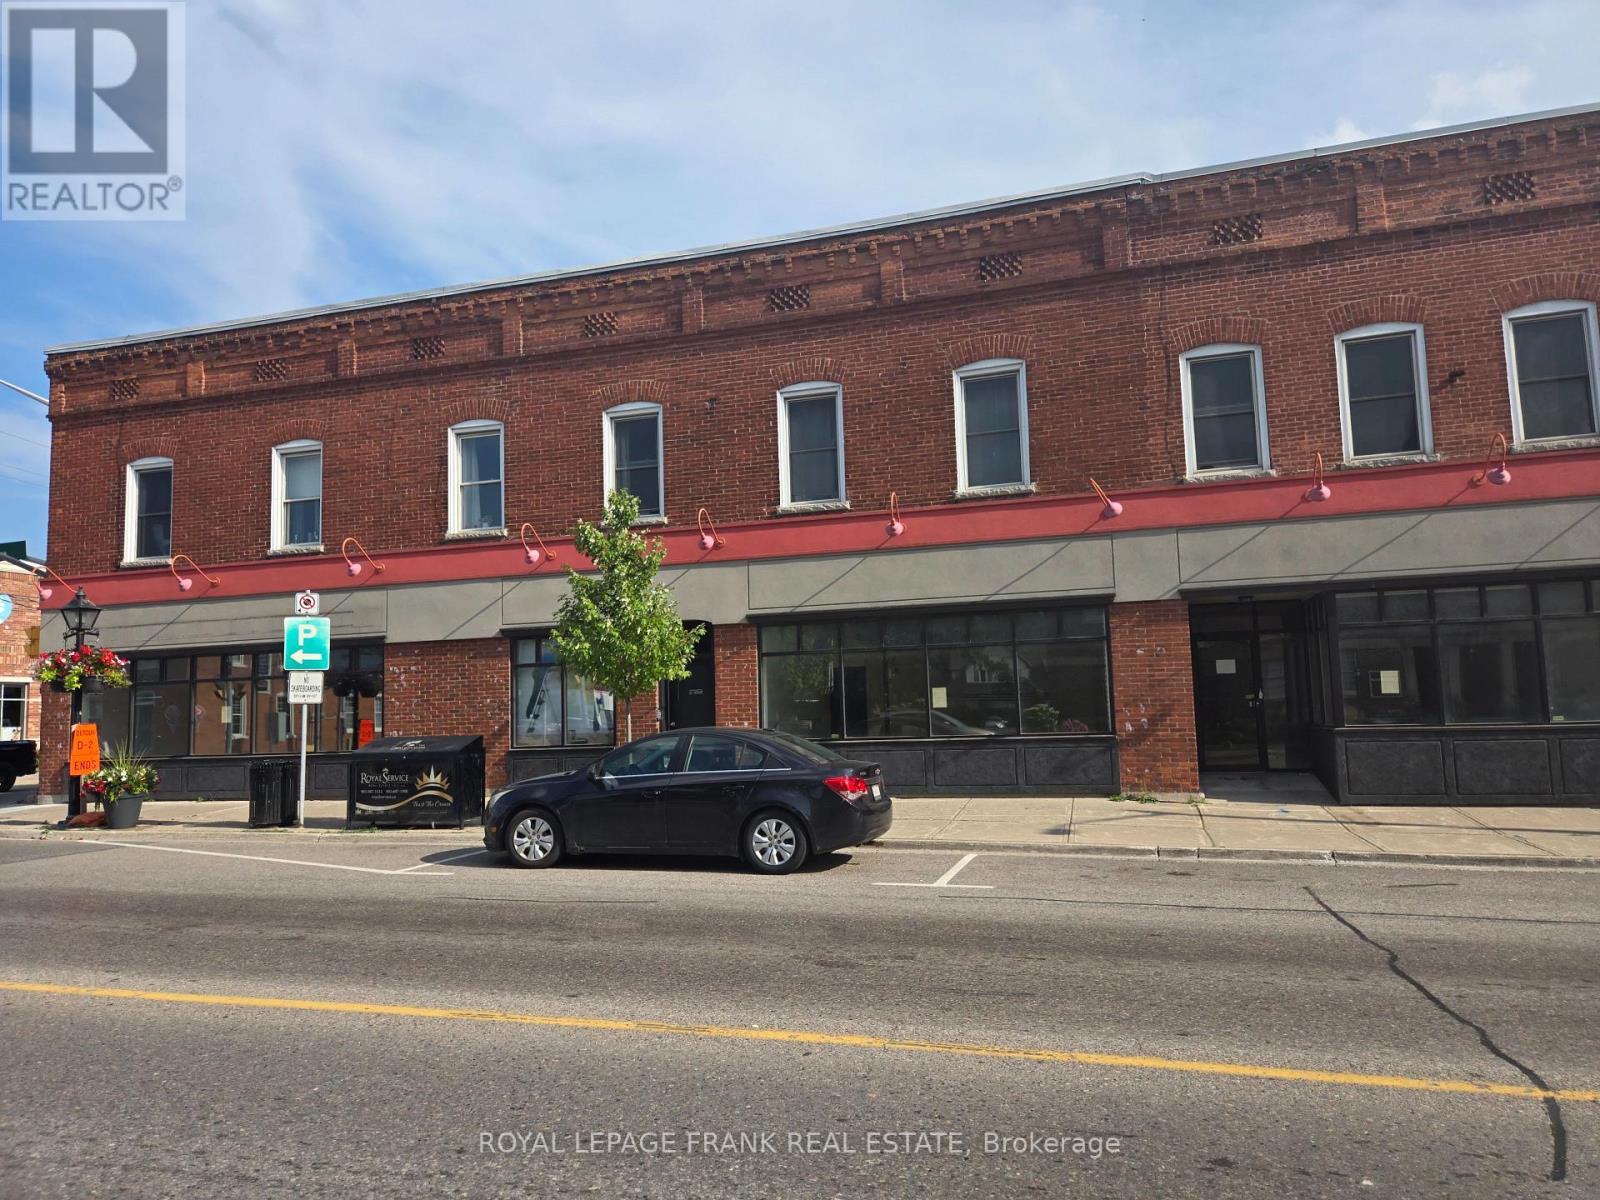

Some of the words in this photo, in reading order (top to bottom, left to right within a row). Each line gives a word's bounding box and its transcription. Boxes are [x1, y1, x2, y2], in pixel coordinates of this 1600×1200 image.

[298, 624, 317, 646] P
[291, 684, 321, 693] SKATEBOARDING
[77, 740, 93, 750] D-2
[74, 760, 96, 770] ENDS
[361, 772, 382, 784] ROYAL
[382, 771, 409, 784] SERVICE
